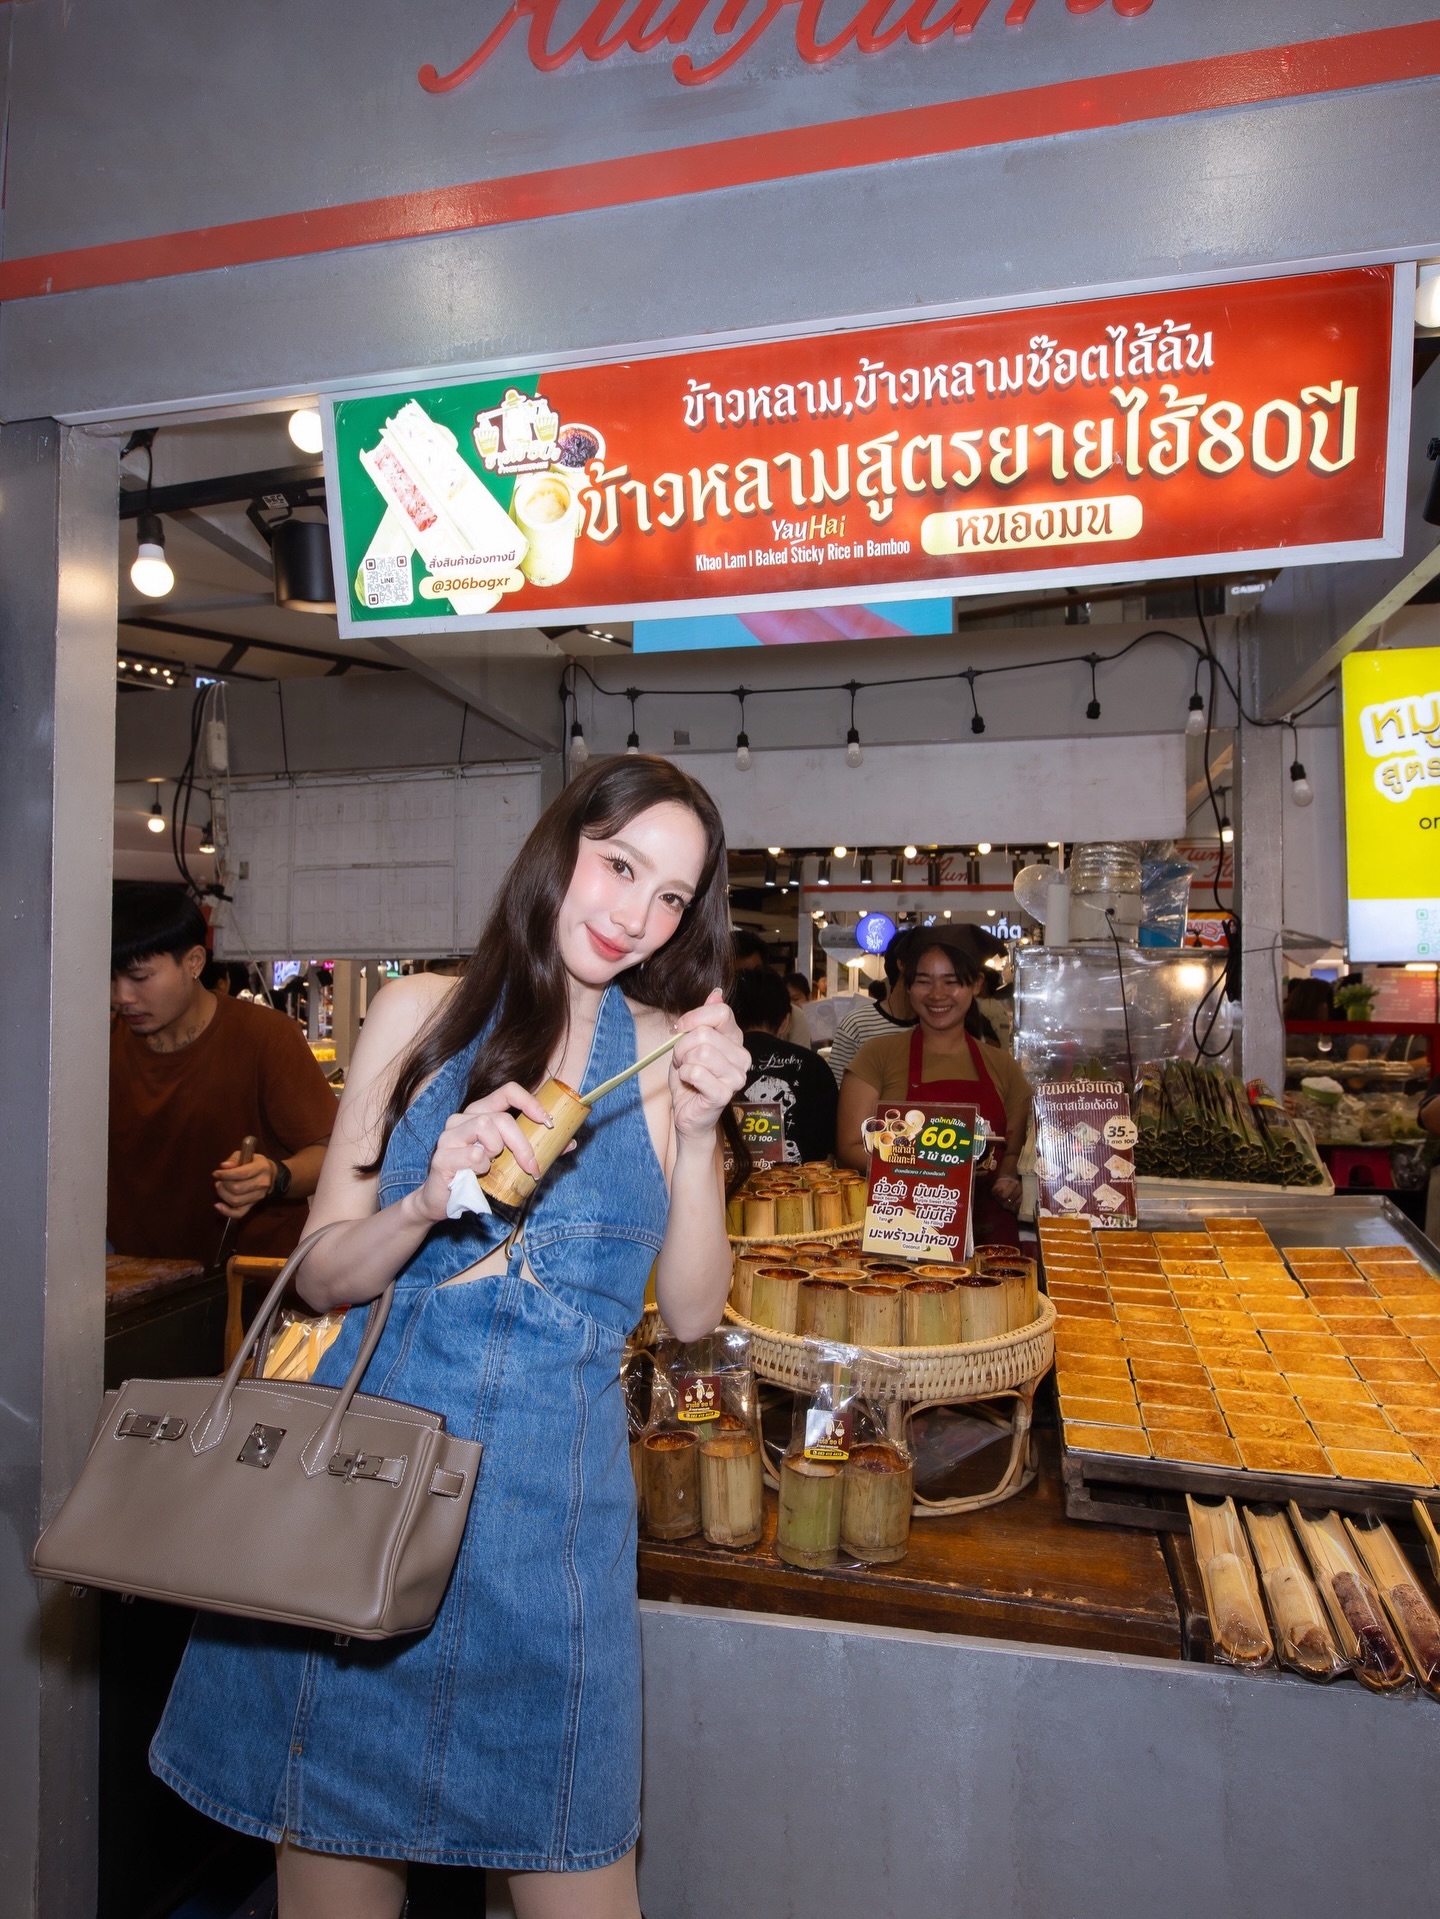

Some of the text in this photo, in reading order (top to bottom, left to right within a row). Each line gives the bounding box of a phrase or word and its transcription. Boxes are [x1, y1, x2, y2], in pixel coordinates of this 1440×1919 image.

[956, 503, 1113, 547] หนองมน
[696, 554, 722, 572] Khao
[725, 552, 746, 570] Lam
[756, 548, 788, 566] Baked
[790, 544, 824, 566] Sticky
[828, 542, 850, 561] Rice
[854, 542, 864, 558] in
[866, 539, 910, 558] Bamboo
[432, 576, 510, 594] @306bogxr
[742, 1118, 780, 1134] 30.-
[1108, 1126, 1134, 1138] 35.-
[921, 1126, 970, 1150] 60.-
[940, 1154, 964, 1164] 100.-
[874, 1178, 959, 1200] ถั่วดำ มันม่วง
[872, 1202, 904, 1216] เผือก
[868, 1227, 958, 1247] มะพร้าวน้ำหอม
